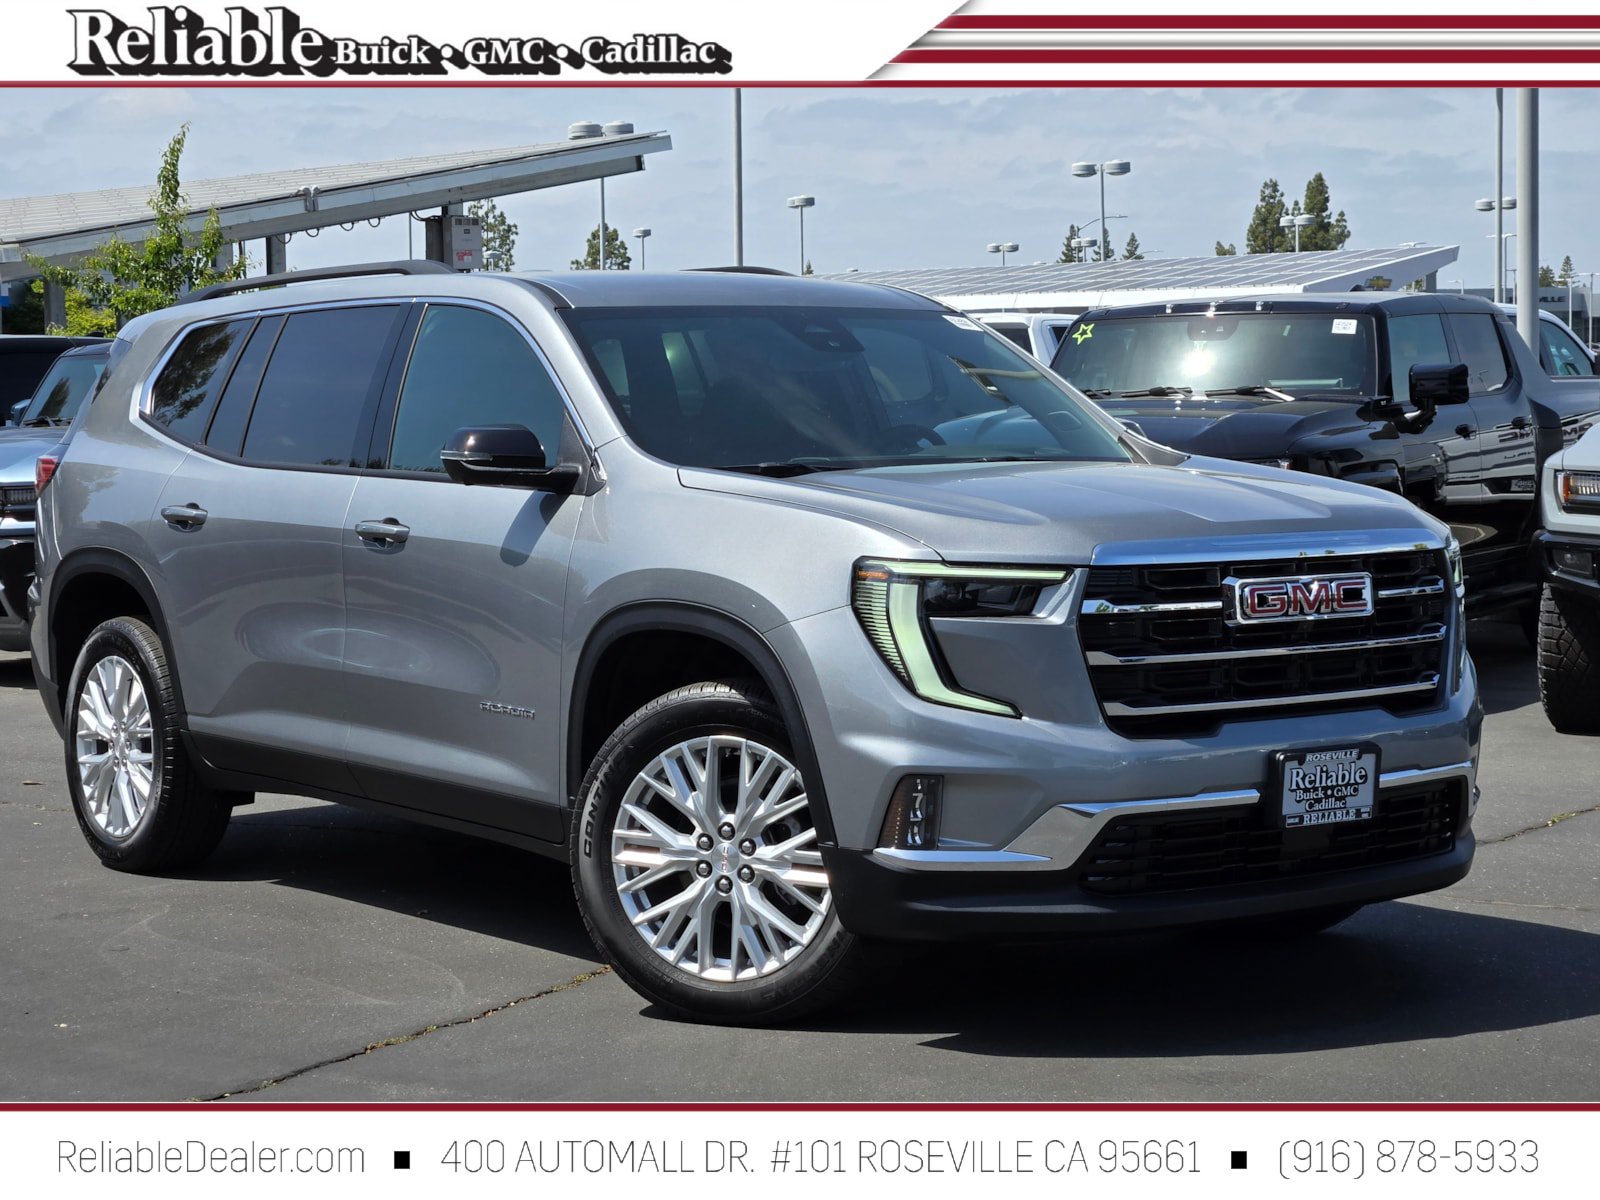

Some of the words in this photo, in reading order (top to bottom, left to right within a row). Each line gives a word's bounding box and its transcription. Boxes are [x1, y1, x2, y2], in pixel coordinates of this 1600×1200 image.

[1243, 579, 1368, 617] GMC
[1306, 750, 1358, 762] ROSEVILLE
[1290, 762, 1367, 791] Reliable
[1296, 788, 1325, 801] Buick
[1333, 785, 1359, 798] GMC
[1305, 798, 1346, 812] Cadillac
[1303, 809, 1356, 825] RELIABLE
